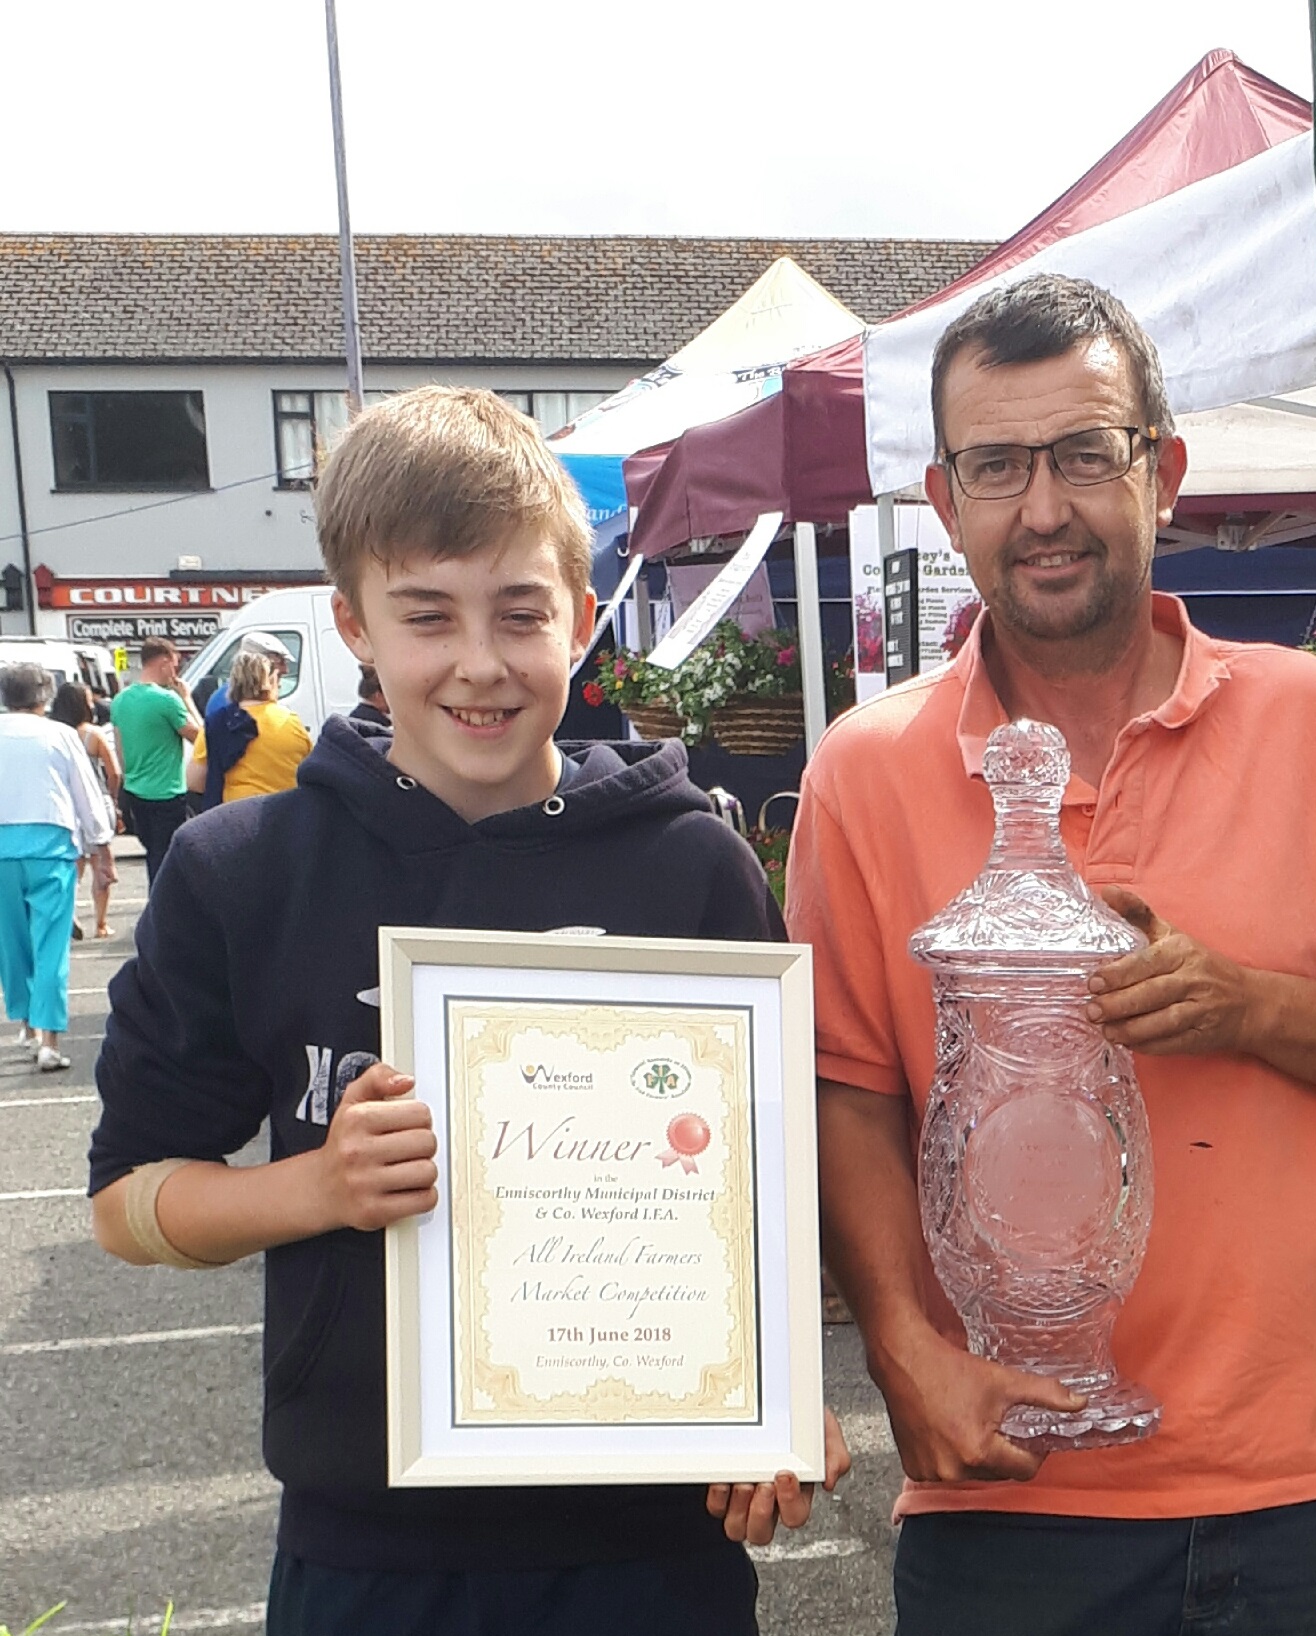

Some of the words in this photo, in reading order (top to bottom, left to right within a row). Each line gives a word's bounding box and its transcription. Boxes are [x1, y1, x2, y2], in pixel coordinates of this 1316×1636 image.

[69, 586, 276, 604] COURTNE
[73, 618, 134, 639] Complete
[137, 618, 168, 636] Print
[170, 618, 217, 636] Service
[519, 1064, 594, 1084] Wexford
[532, 1082, 561, 1091] County
[563, 1083, 594, 1091] Council
[491, 1115, 652, 1161] Winner
[593, 1174, 603, 1182] in
[605, 1174, 619, 1182] the
[495, 1186, 581, 1203] Enniscorthy
[585, 1187, 658, 1203] Municipal
[661, 1187, 716, 1201] District
[535, 1207, 548, 1219] &
[552, 1207, 576, 1219] Co.
[581, 1206, 639, 1223] Wexford
[642, 1208, 679, 1220] I.F.A.
[513, 1236, 563, 1266] All
[561, 1236, 640, 1266] Ireland
[634, 1244, 703, 1265] Farmers
[510, 1274, 592, 1302] Market
[599, 1281, 709, 1320] Competition
[548, 1326, 583, 1342] 17th
[589, 1326, 630, 1345] June
[634, 1327, 671, 1342] 2018
[536, 1354, 610, 1369] Enniscorthy,
[613, 1355, 632, 1367] Co.
[636, 1354, 684, 1370] Wexford
